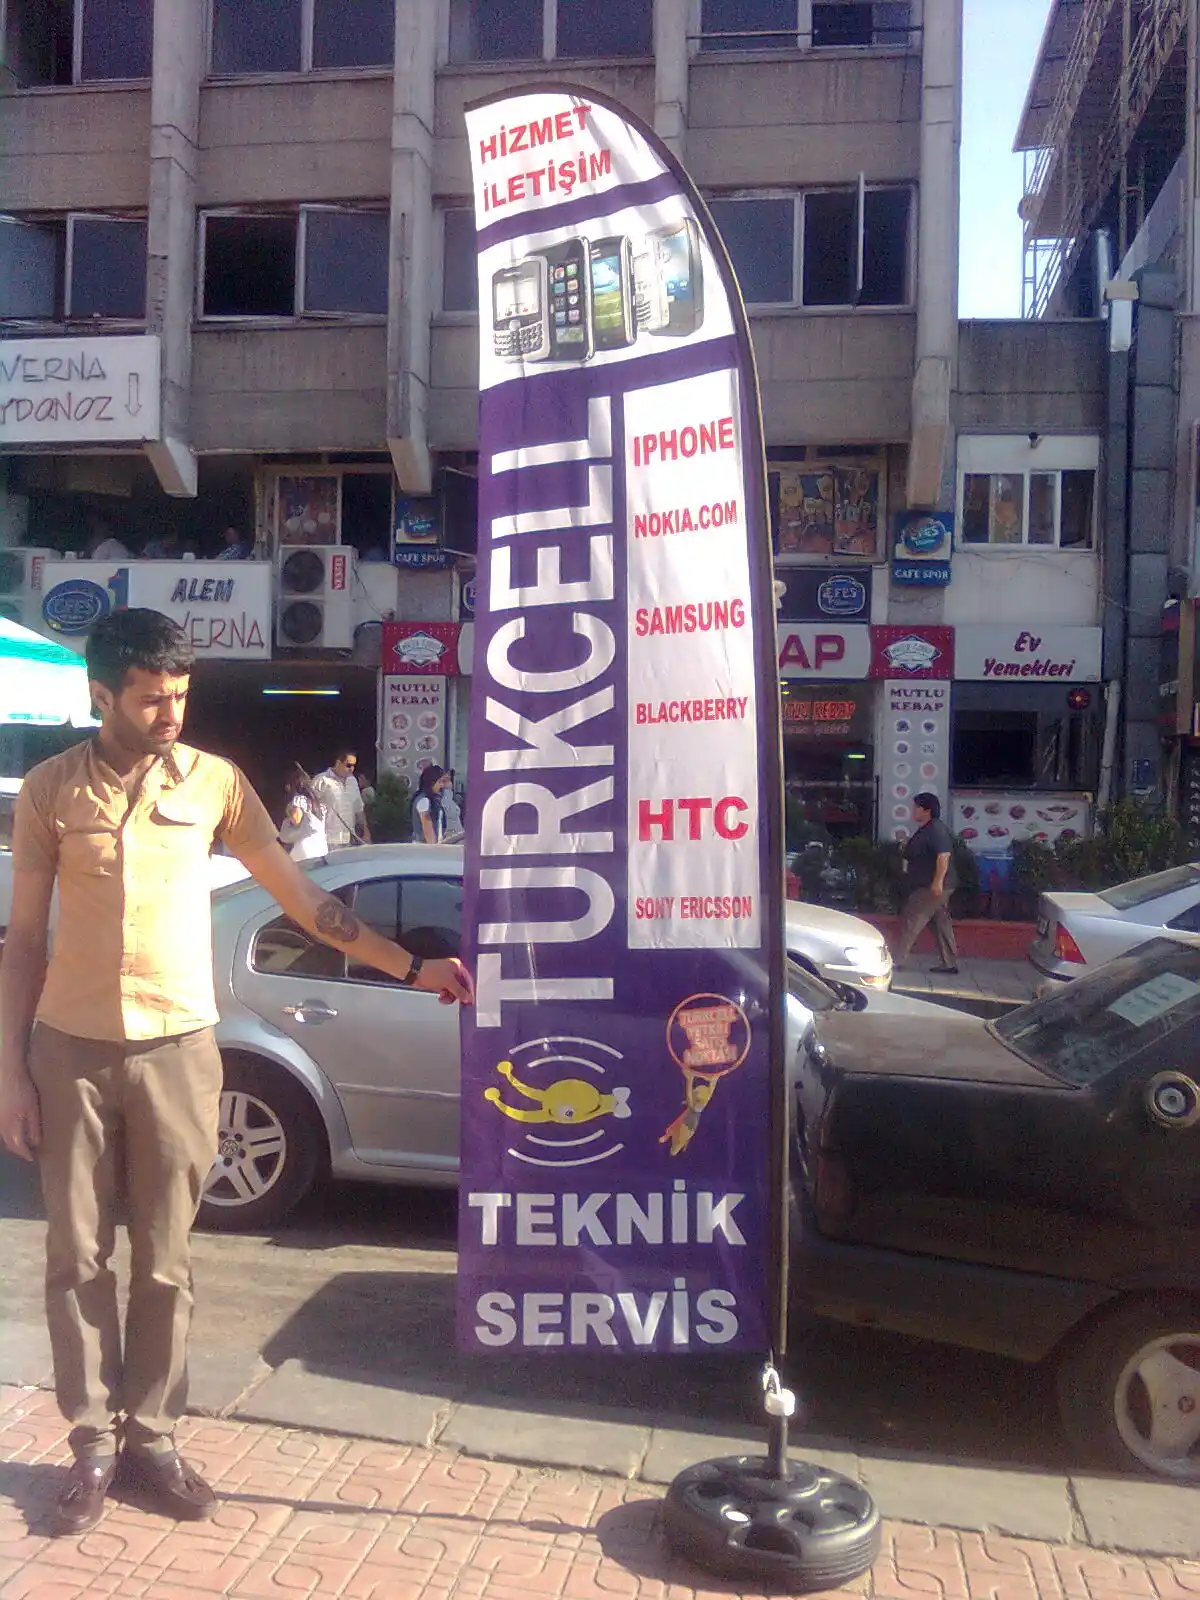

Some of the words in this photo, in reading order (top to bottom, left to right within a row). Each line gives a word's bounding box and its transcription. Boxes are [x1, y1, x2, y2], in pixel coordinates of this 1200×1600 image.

[479, 104, 592, 165] HİZMET
[483, 148, 612, 212] İLETİŞİM
[633, 416, 734, 467] IPHONE
[634, 499, 738, 538] NOKIA.COM
[635, 598, 745, 637] SAMSUNG
[1014, 631, 1042, 653] Ev
[983, 658, 1076, 677] Yemekleri
[390, 683, 440, 693] MUTLU
[390, 695, 440, 706] KEBAP
[890, 688, 945, 698] MUTLU
[890, 701, 944, 711] KEBAP
[475, 395, 616, 1028] TURKCELL
[636, 696, 749, 724] BLACKBERRY
[638, 796, 749, 842] HTC
[635, 896, 675, 920] SONY
[680, 895, 752, 919] ERICSSON
[468, 1179, 747, 1246] TEKNİK
[475, 1277, 739, 1347] SERVİS
